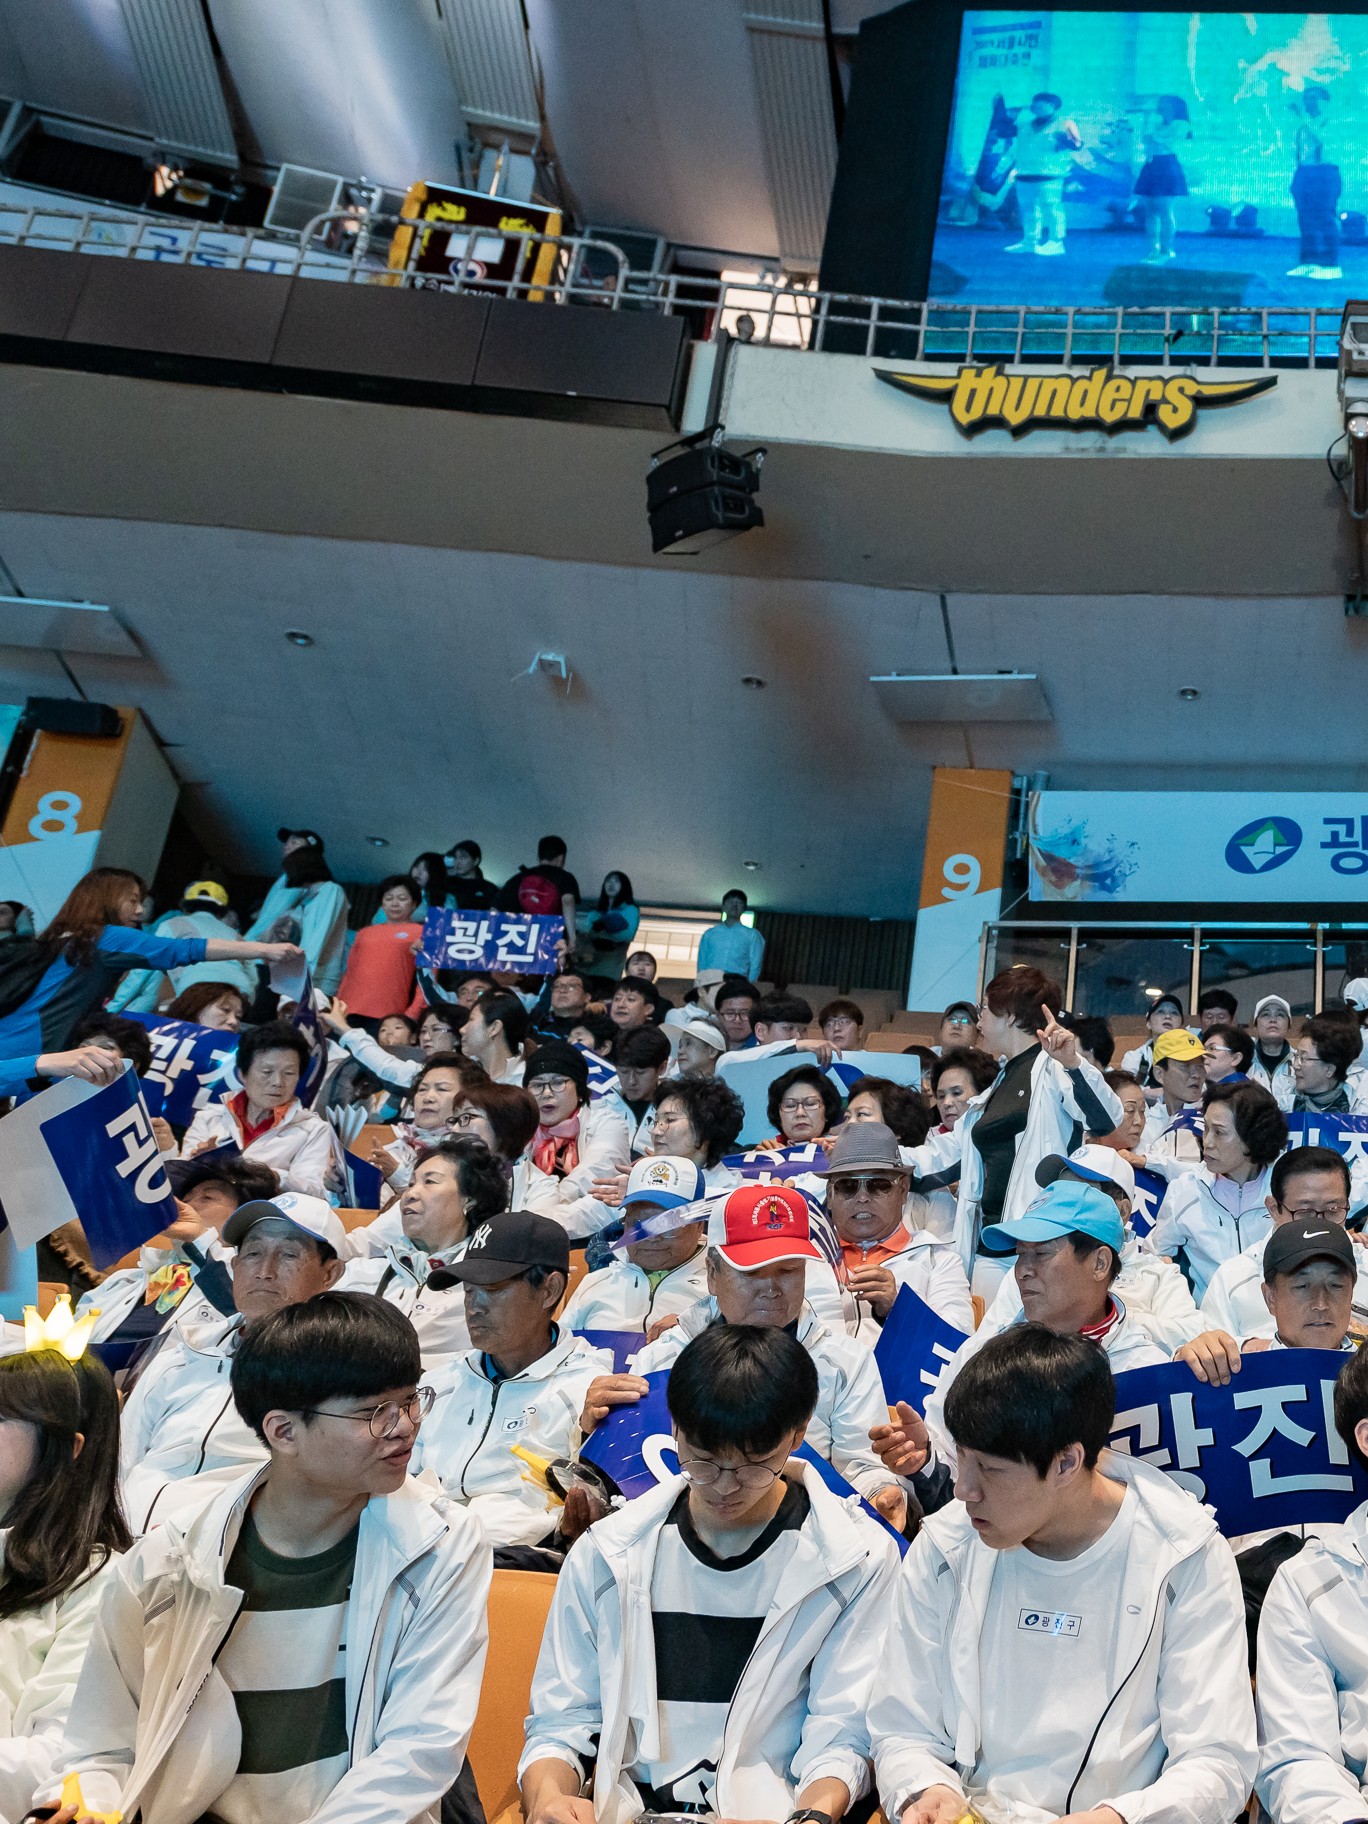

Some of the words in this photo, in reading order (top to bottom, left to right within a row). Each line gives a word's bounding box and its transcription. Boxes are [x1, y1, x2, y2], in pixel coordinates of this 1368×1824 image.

[951, 364, 1201, 432] thunders
[28, 790, 82, 842] 8
[941, 852, 983, 900] 9
[445, 920, 540, 963] 광진
